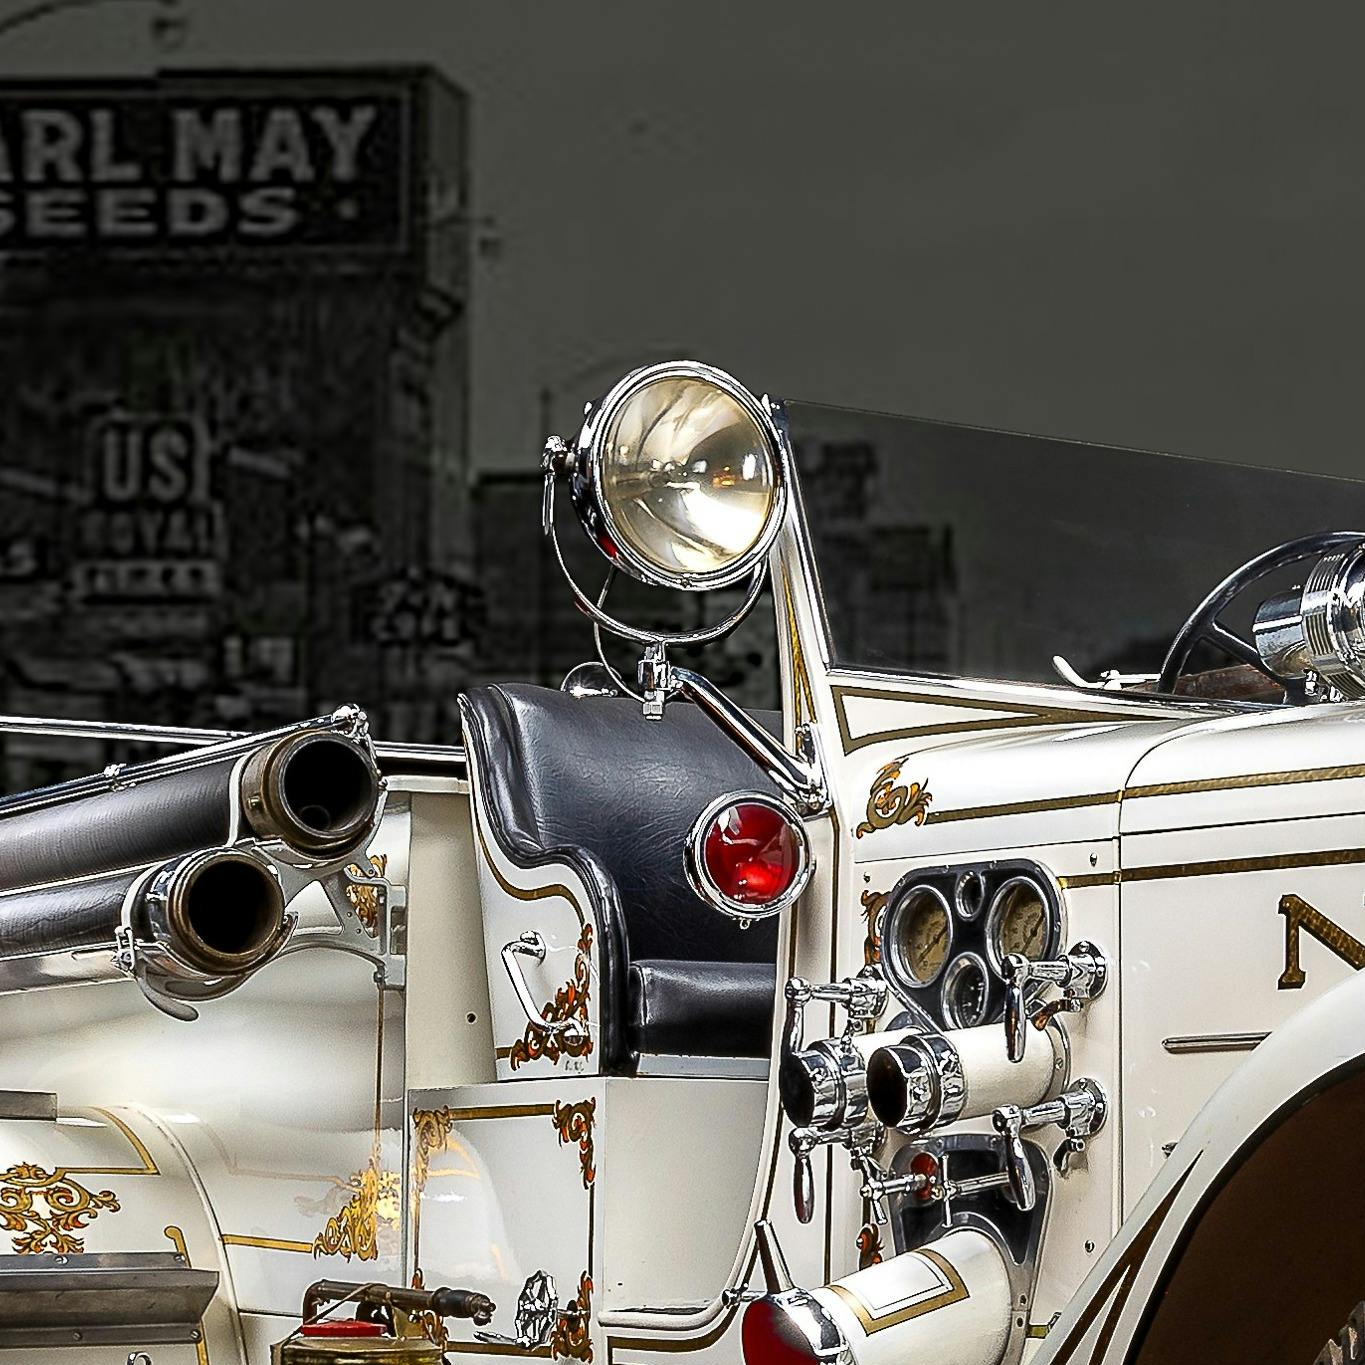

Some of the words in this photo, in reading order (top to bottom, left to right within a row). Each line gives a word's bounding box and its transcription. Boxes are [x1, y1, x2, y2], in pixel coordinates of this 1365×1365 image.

[0, 106, 144, 184] RL
[168, 103, 379, 184] MAY
[0, 185, 301, 240] EEDS
[103, 427, 189, 502] US
